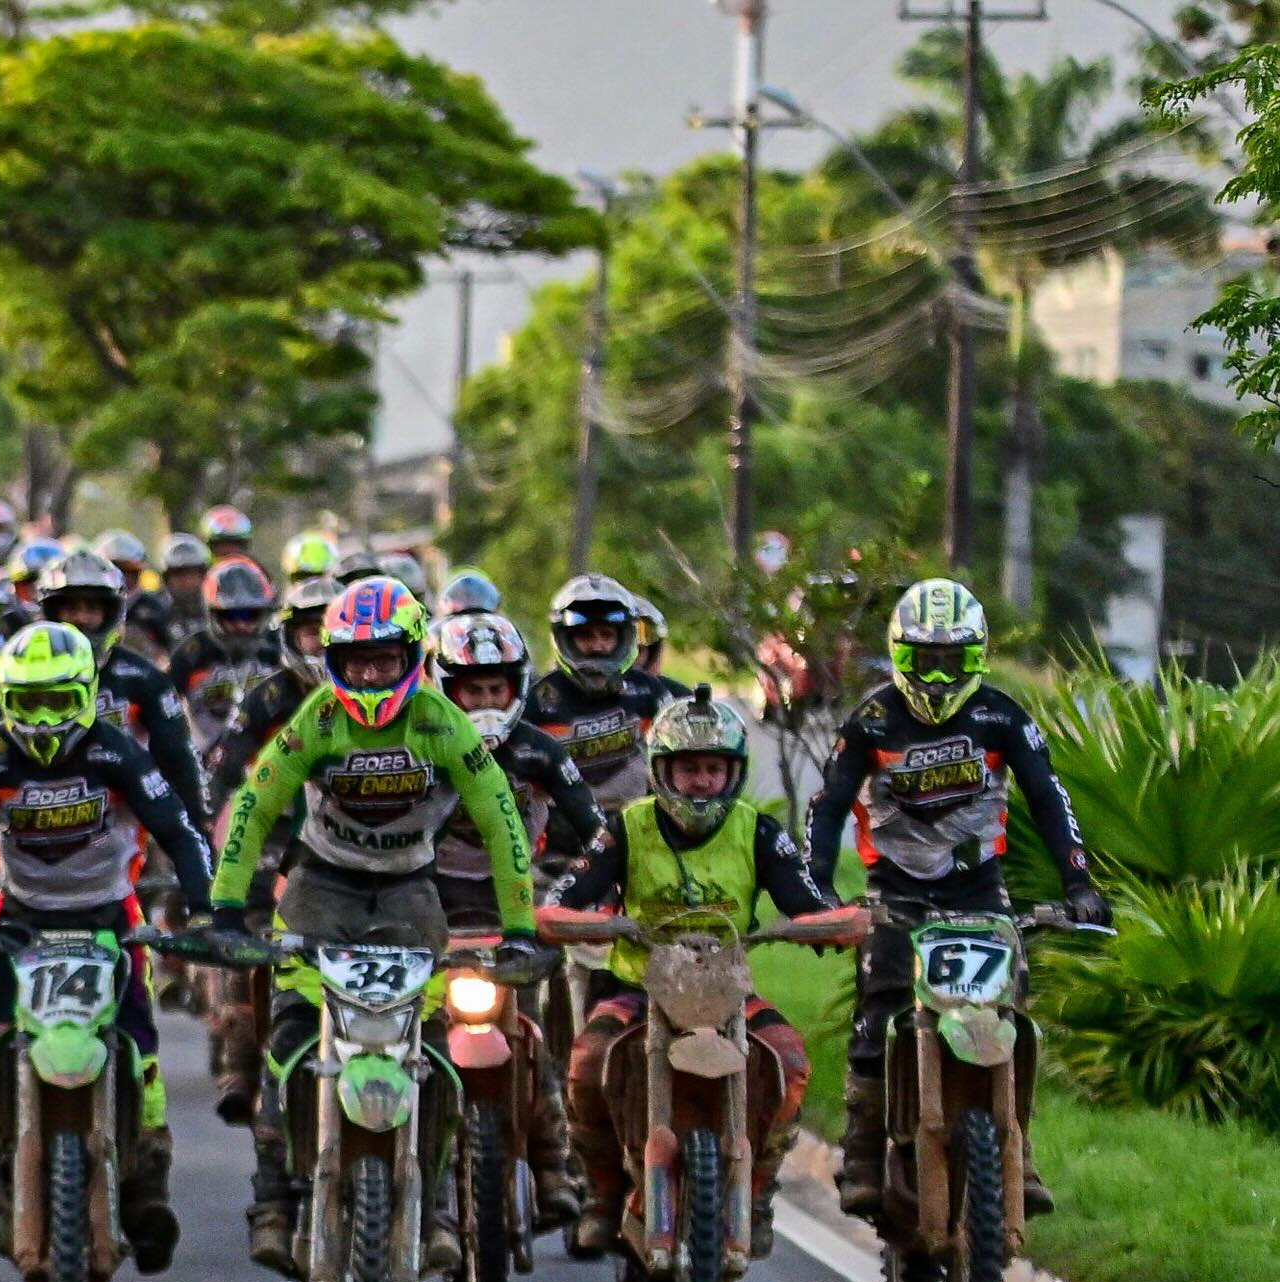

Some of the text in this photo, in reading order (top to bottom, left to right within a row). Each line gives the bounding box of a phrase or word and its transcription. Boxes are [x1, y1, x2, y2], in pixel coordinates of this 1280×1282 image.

[351, 755, 406, 771] 2025
[25, 788, 80, 806] 2025
[345, 961, 408, 990] 34
[927, 943, 1006, 985] 67
[29, 962, 102, 1011] 114
